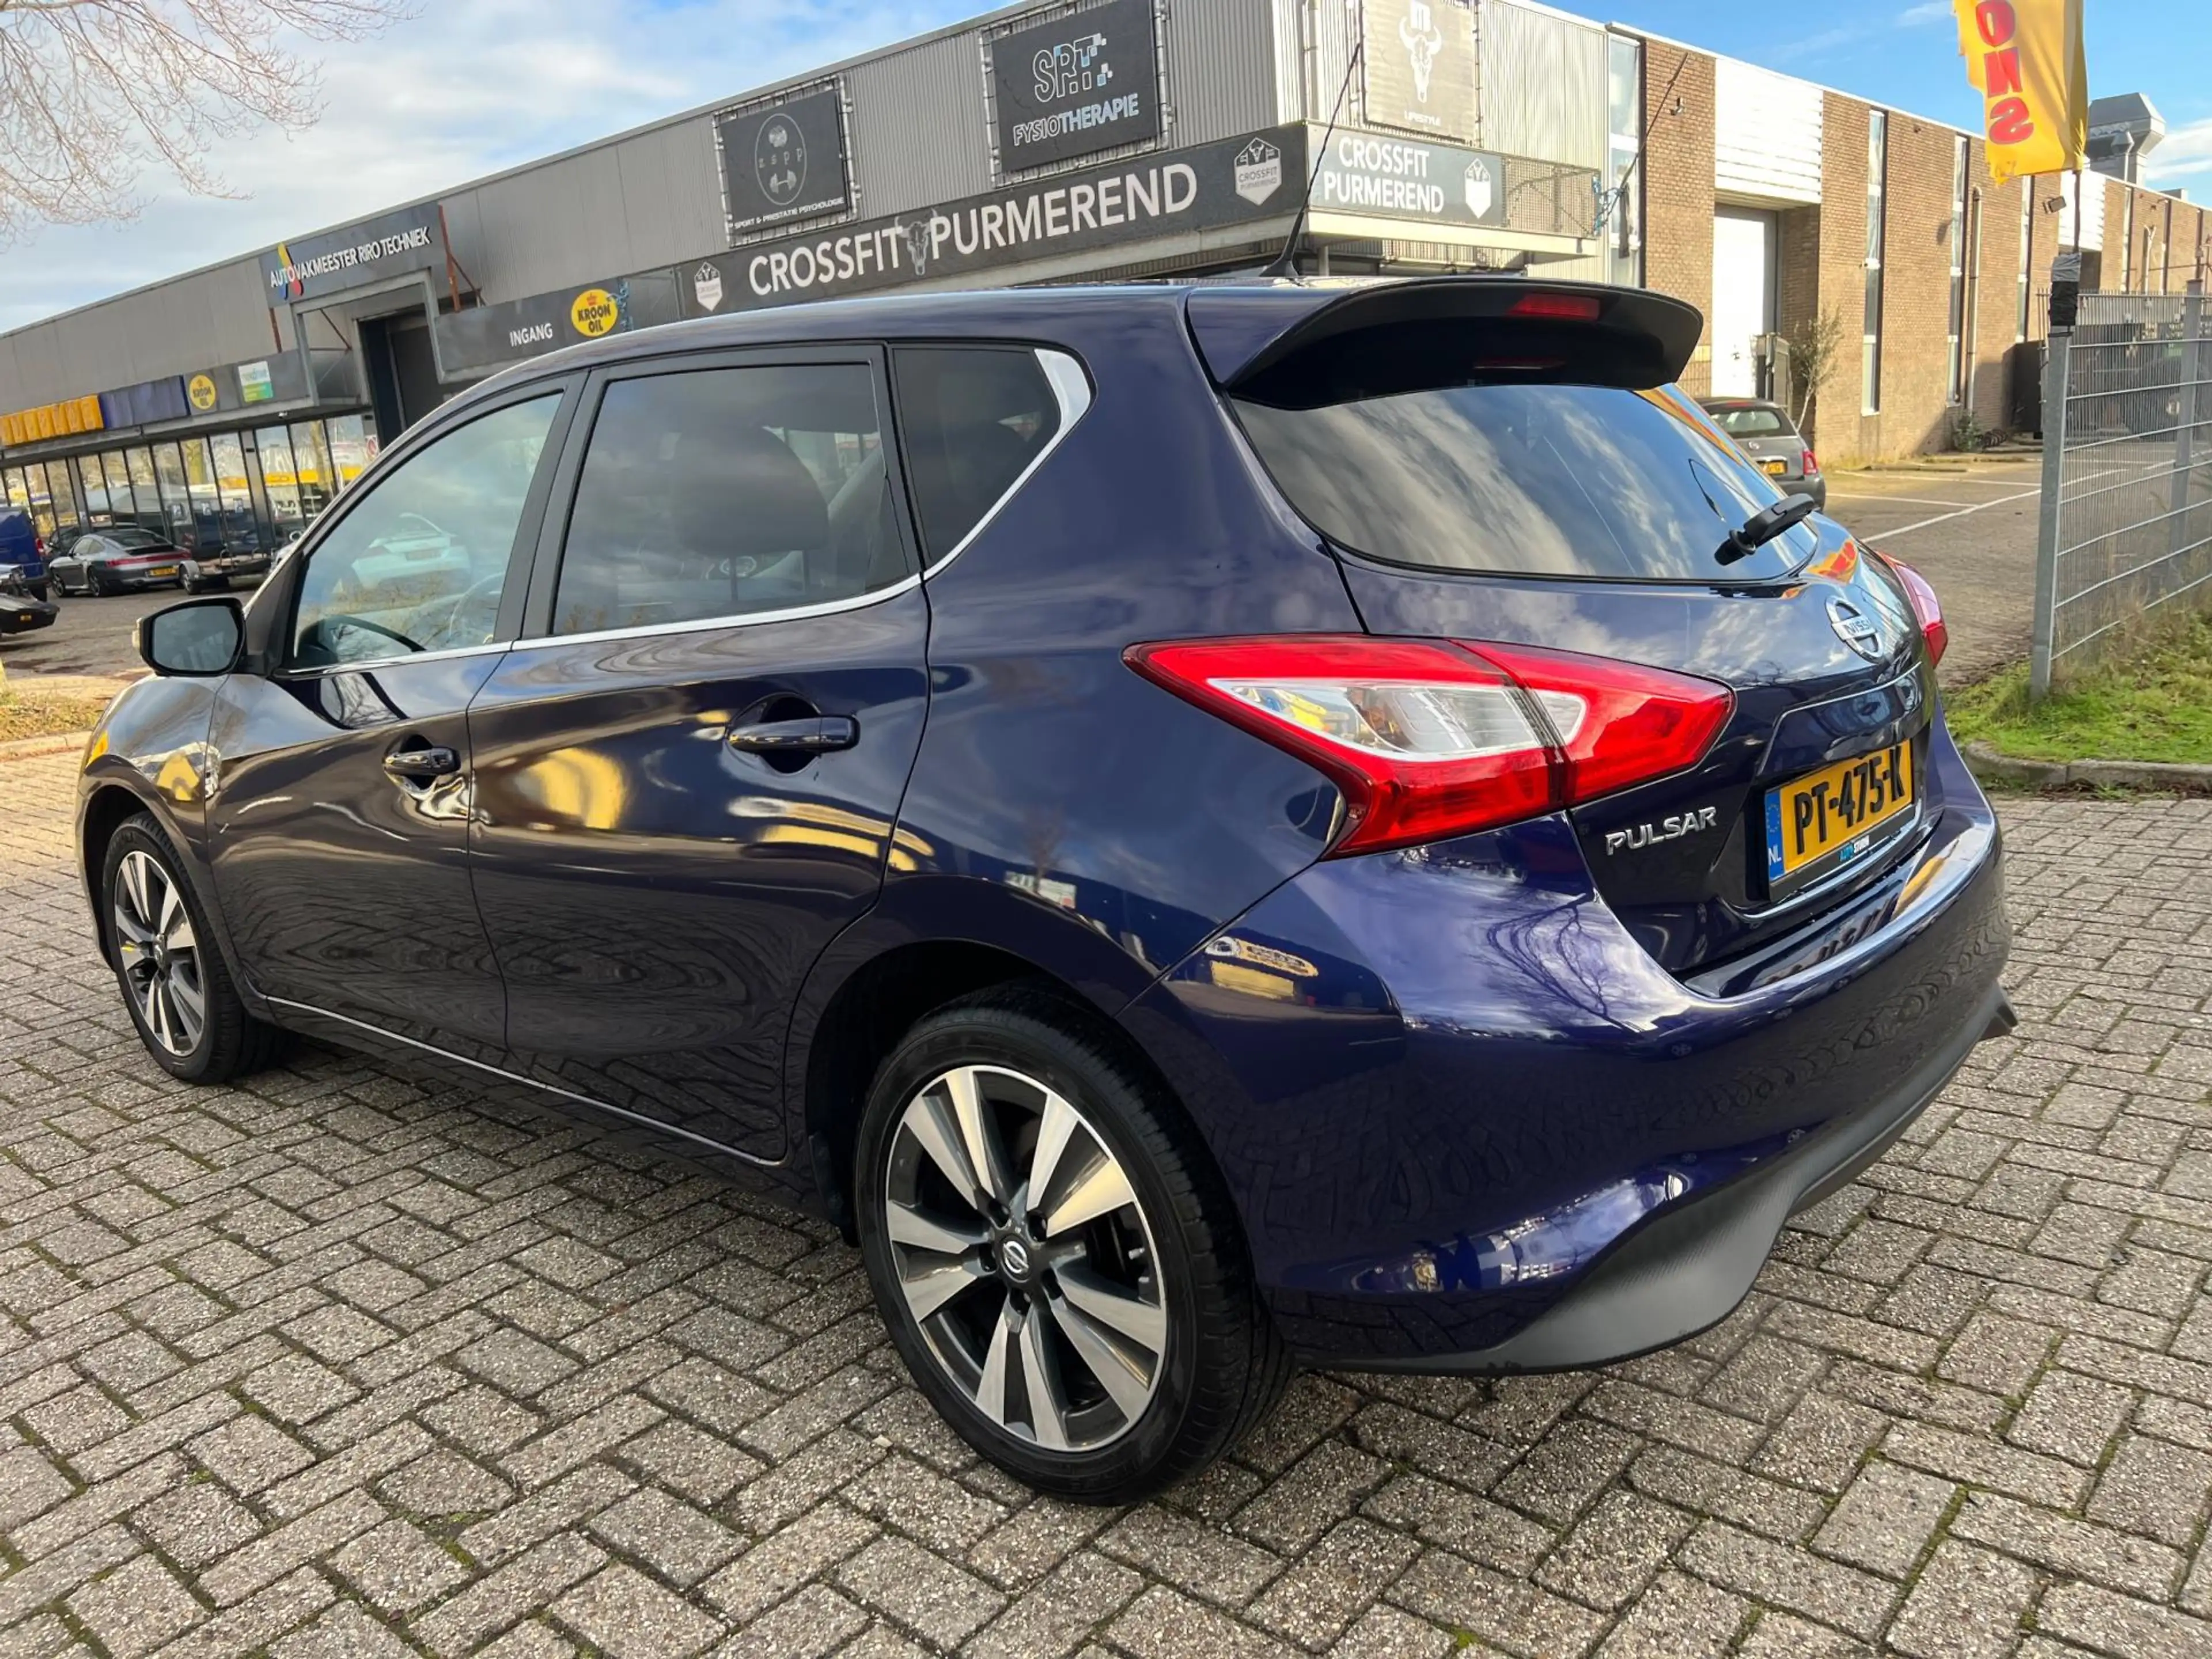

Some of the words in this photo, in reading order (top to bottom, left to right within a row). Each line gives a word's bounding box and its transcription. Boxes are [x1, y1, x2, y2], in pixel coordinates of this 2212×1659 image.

[1033, 33, 1107, 103] SRT
[1013, 93, 1139, 146] FYSIOTHERAPIE
[1238, 166, 1278, 183] CROSSFIT
[1339, 136, 1430, 179] CROSSFIT
[1323, 171, 1444, 213] PURMEREND
[734, 217, 755, 229] SPORT
[749, 227, 903, 296] CROSSFIT
[929, 163, 1197, 260] PURMEREND
[270, 249, 362, 288] AUTOVAKMEESTER
[358, 240, 381, 263] RIRO
[381, 226, 431, 256] TECHNIEK
[577, 304, 611, 322] KROON
[588, 319, 604, 334] OIL
[509, 323, 553, 347] INGANG
[1794, 745, 1906, 855] PT-475-K
[1604, 806, 1717, 856] PULSAR
[1767, 844, 1782, 866] NL
